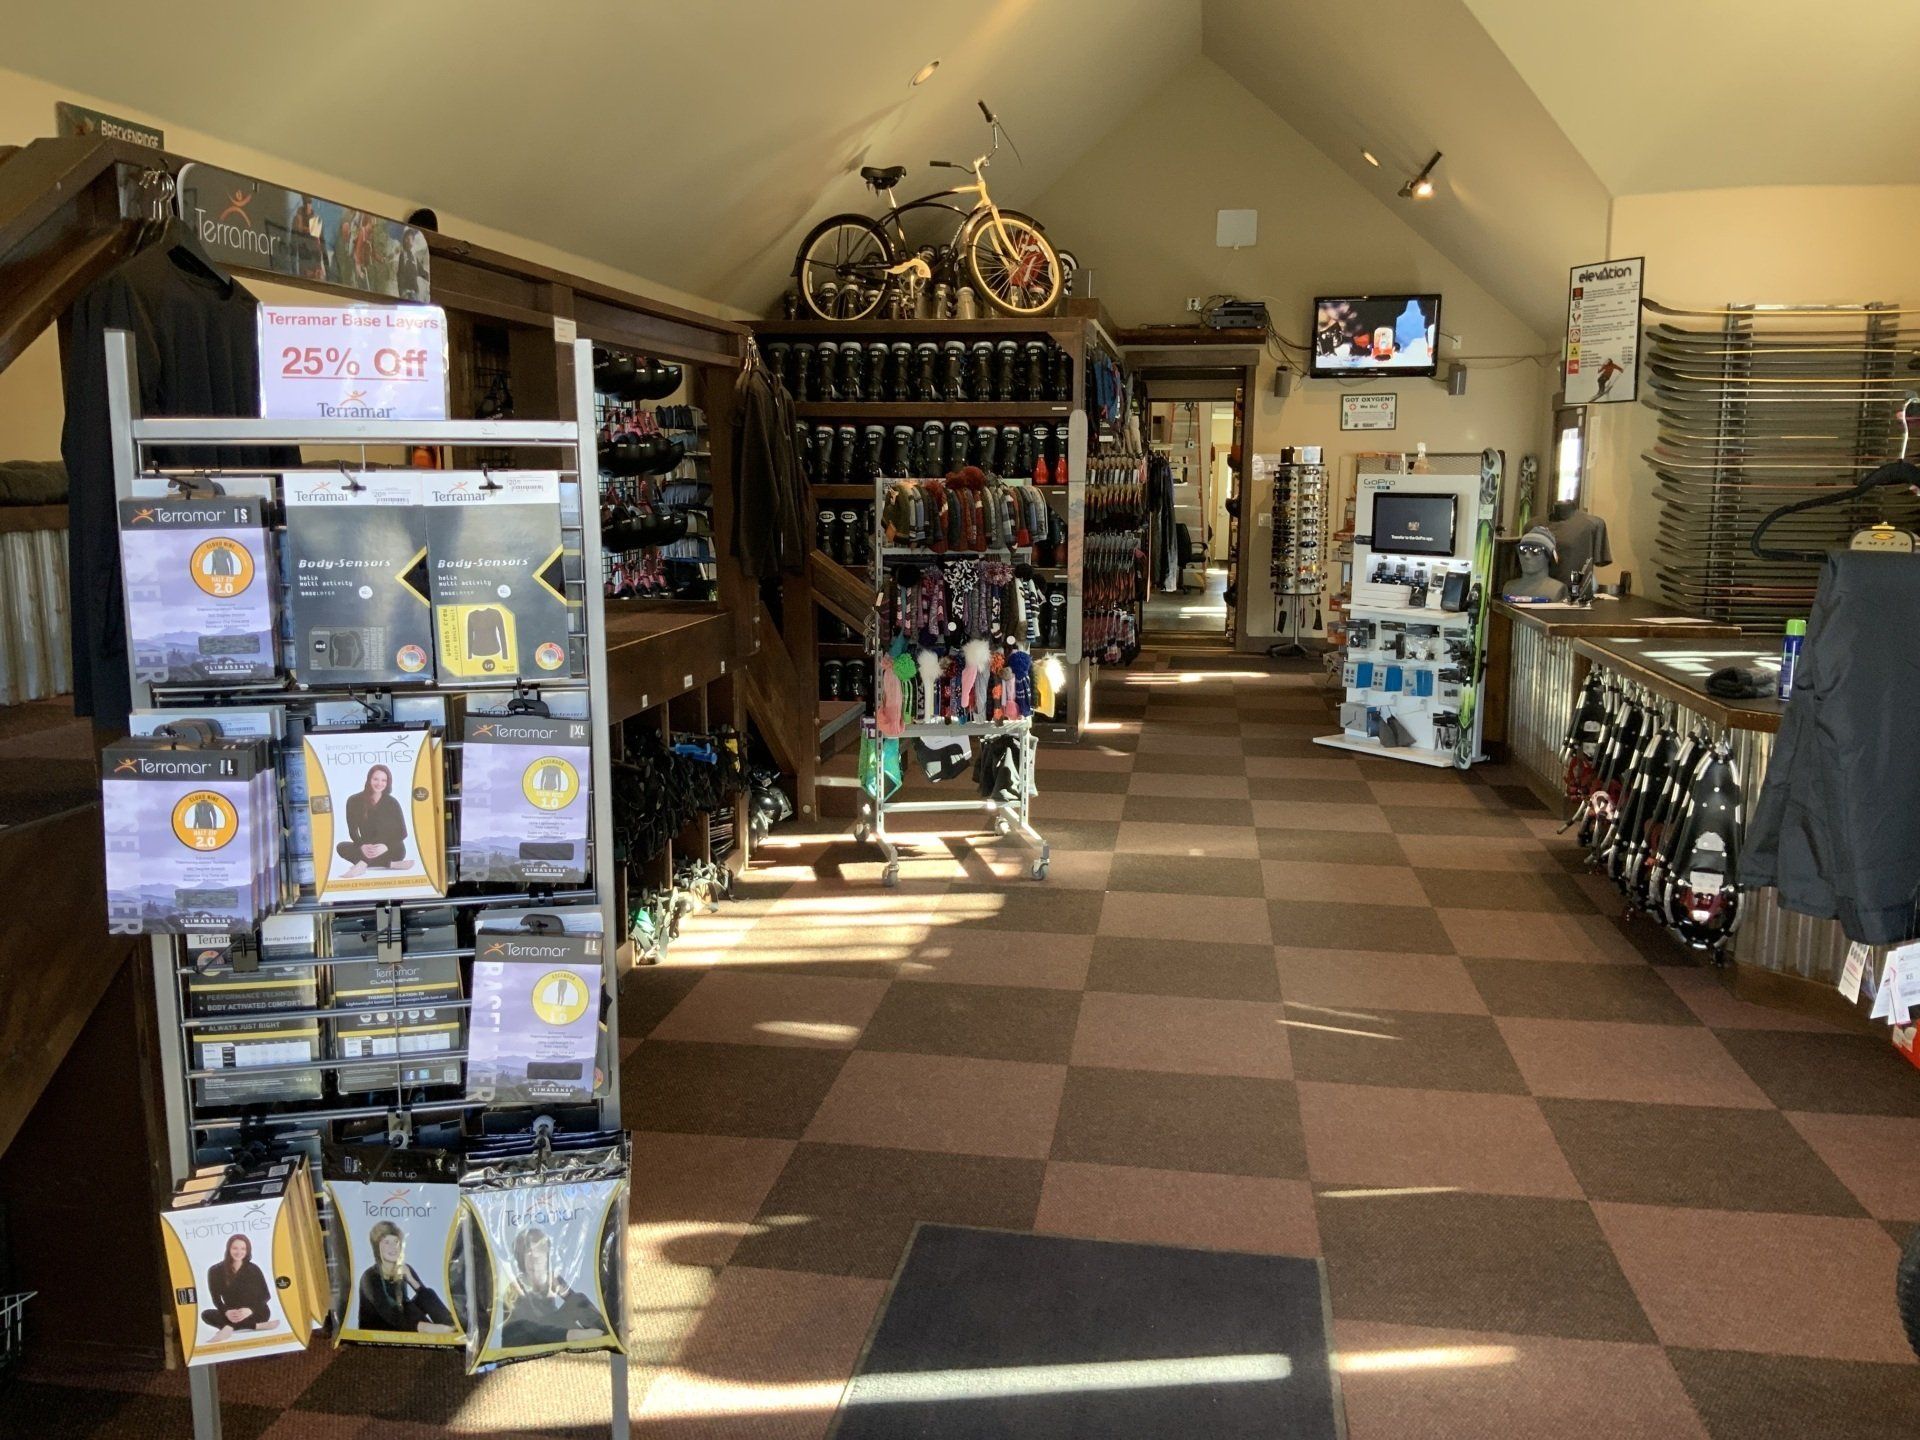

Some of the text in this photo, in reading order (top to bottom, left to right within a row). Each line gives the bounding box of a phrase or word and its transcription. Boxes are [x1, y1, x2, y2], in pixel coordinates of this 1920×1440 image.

[101, 119, 160, 149] BRECKENRIDGE
[194, 208, 277, 255] Terramar
[267, 312, 439, 330] Terramar Base Layers
[282, 346, 428, 377] 25% Off
[317, 402, 394, 419] Terramar
[294, 490, 349, 502] Terramar
[432, 490, 486, 502] Terramar
[155, 507, 222, 523] Terramar
[240, 508, 248, 519] S
[298, 558, 391, 570] Body-Sensors
[437, 558, 529, 569] Body-Sensors
[214, 583, 234, 594] 2.0
[1414, 586, 1420, 594] 7
[204, 664, 254, 672] CLIMASENSE
[495, 724, 554, 739] Terramar
[574, 724, 585, 736] XL
[138, 758, 208, 774] Terramar
[227, 759, 234, 771] L
[196, 836, 216, 848] 2.0
[506, 943, 566, 958] Terramar
[591, 941, 596, 951] L
[207, 999, 301, 1011] BODY ACTIVATED COMFORT
[208, 1021, 280, 1032] ALWAYS JUST RIGHT
[404, 1171, 418, 1179] up
[363, 1200, 433, 1218] Terramar
[505, 1208, 581, 1227] Terramar
